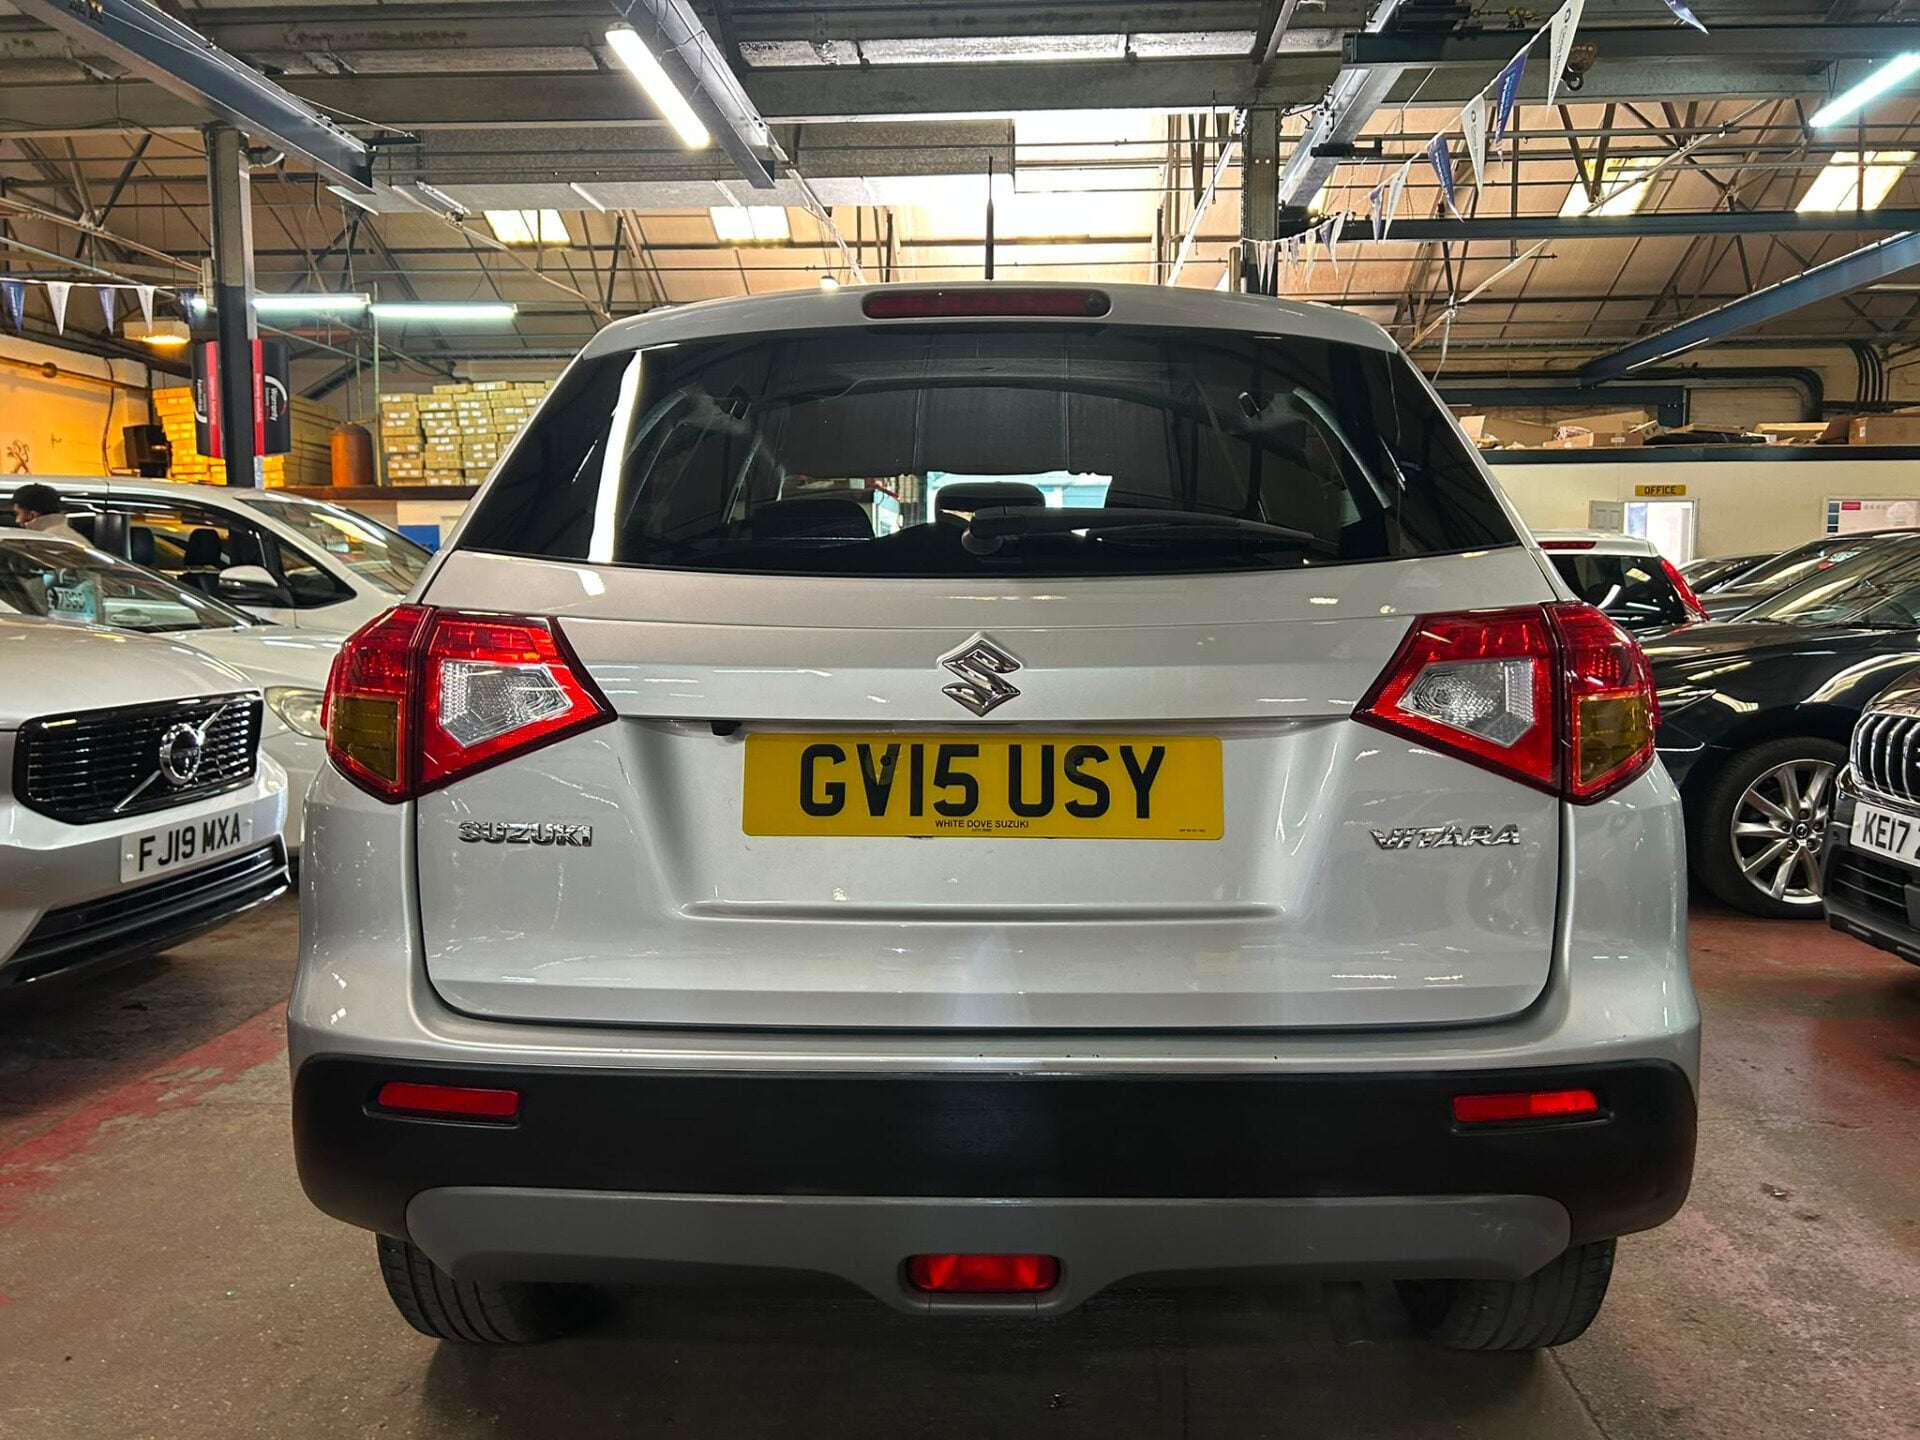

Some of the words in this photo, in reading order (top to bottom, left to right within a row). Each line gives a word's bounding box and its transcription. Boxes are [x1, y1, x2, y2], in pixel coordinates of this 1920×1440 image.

[1644, 484, 1677, 496] OFFICE
[800, 743, 979, 817] GV15
[1008, 744, 1166, 819] USY
[458, 821, 593, 847] SUZUKI
[935, 819, 965, 828] WHITE
[966, 819, 993, 828] DOVE
[995, 820, 1029, 828] SUZUKI
[1369, 823, 1521, 850] VITARA
[1862, 811, 1911, 853] KE17
[139, 826, 195, 872] FJ19
[202, 812, 240, 854] MXA
